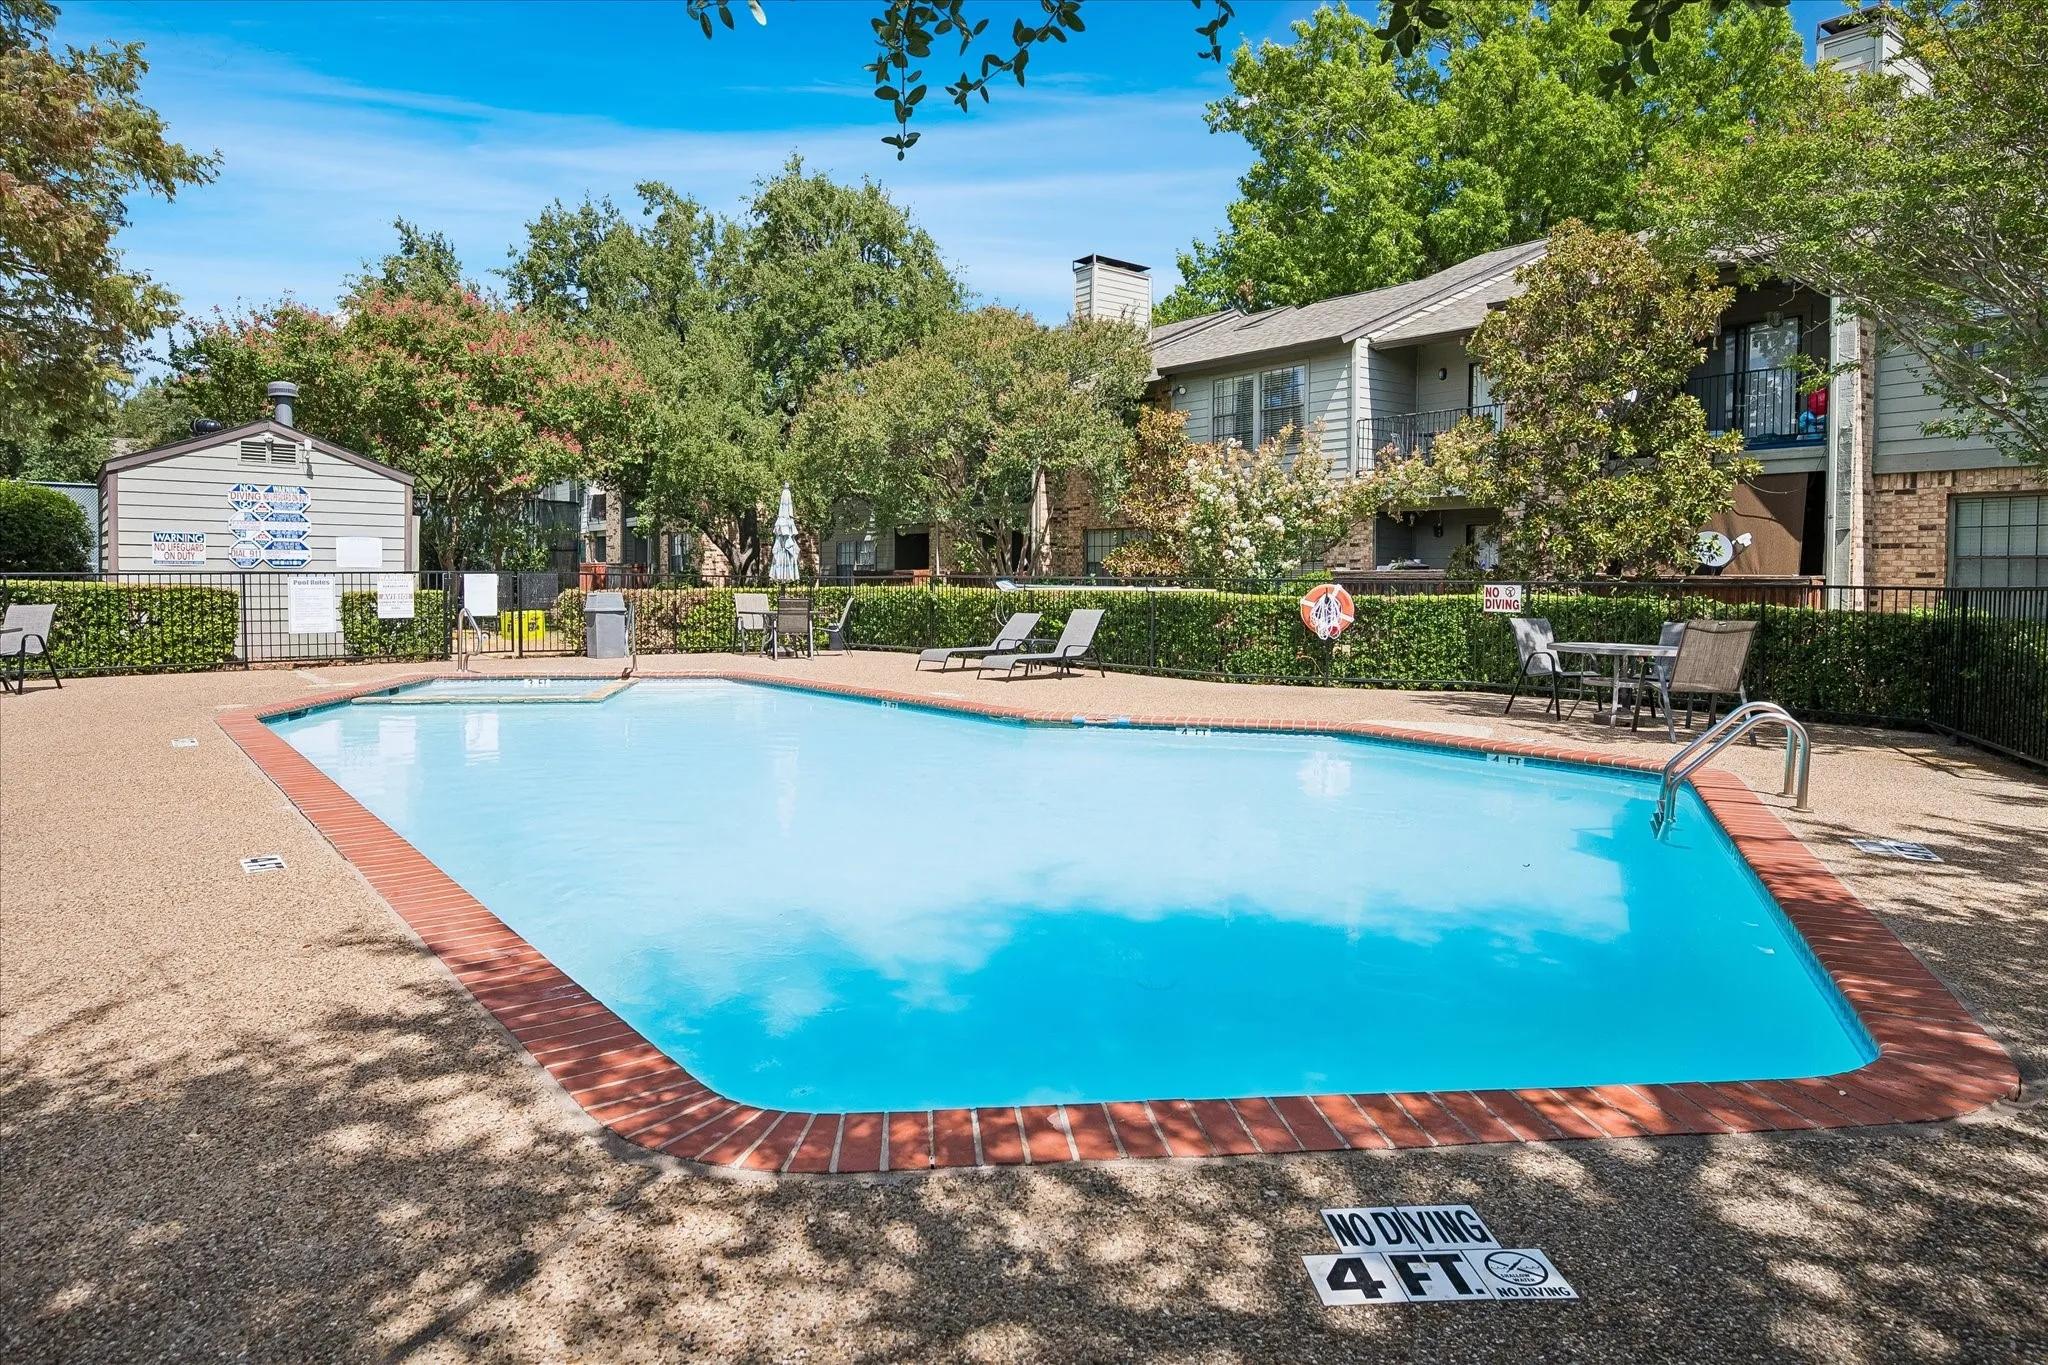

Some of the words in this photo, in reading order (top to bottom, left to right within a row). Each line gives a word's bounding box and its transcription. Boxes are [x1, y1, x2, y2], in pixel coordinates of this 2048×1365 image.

[240, 484, 252, 492] NO
[230, 492, 261, 500] DIVING
[154, 533, 204, 543] WARNING
[154, 543, 166, 551] NO
[168, 543, 204, 552] LIFEGUARD
[164, 552, 175, 560] ON
[177, 552, 200, 560] DUTY
[231, 549, 246, 557] DIAL
[249, 549, 262, 558] 911
[1485, 587, 1500, 598] NO
[1485, 599, 1520, 610] DIVING
[1327, 1212, 1376, 1247] NO
[1371, 1209, 1492, 1246] DIVING
[1326, 1256, 1387, 1299] 4
[1388, 1253, 1486, 1297] FT.
[1496, 1286, 1519, 1298] NO
[1519, 1286, 1571, 1297] DIVING
